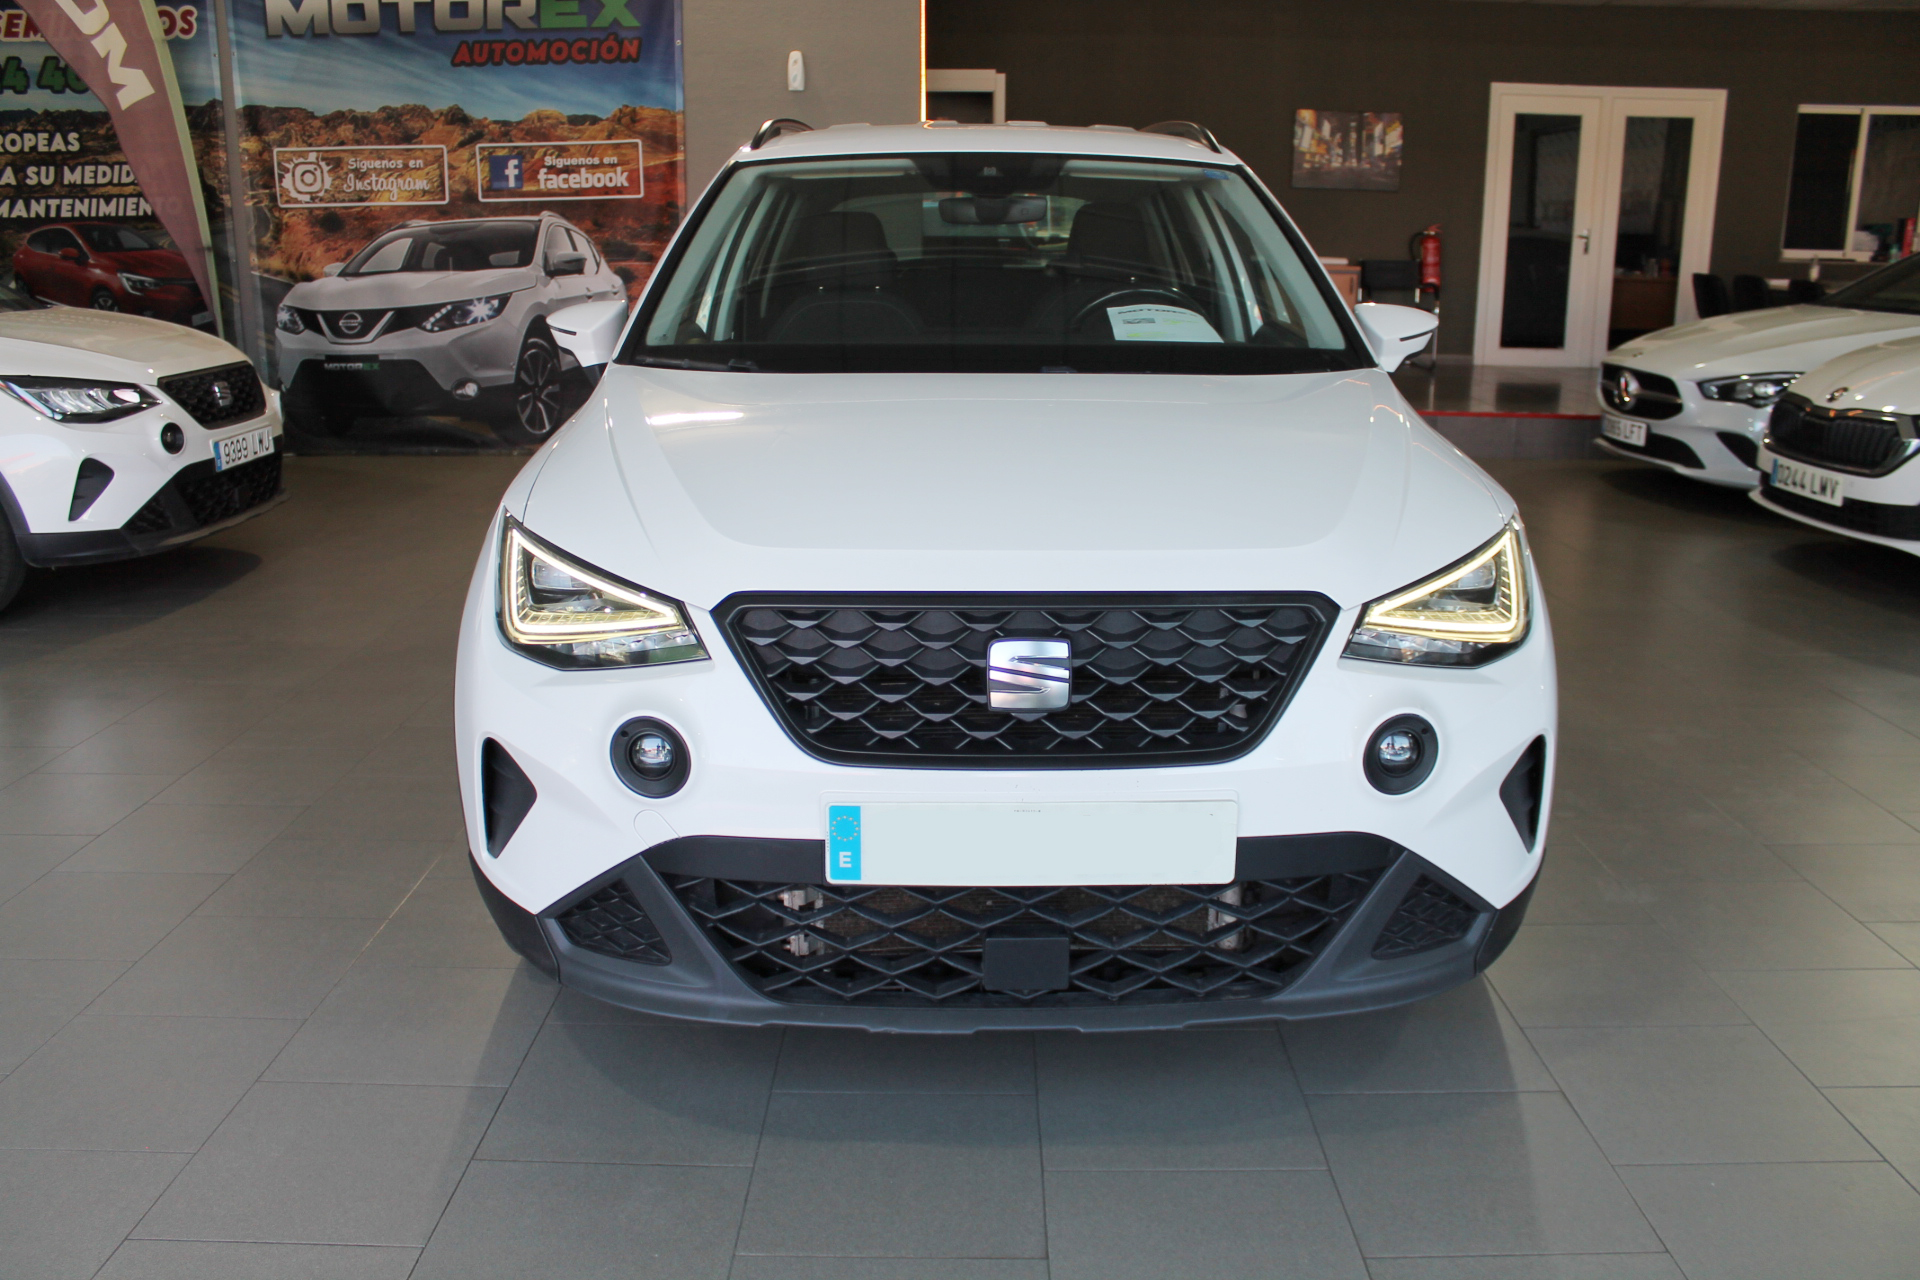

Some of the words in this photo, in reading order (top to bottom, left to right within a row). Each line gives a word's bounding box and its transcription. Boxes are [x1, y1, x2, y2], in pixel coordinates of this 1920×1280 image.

[265, 0, 642, 36] MOTOREX
[453, 34, 640, 66] AUTOMOCIÓN
[408, 159, 424, 168] en
[603, 156, 618, 164] en
[25, 165, 55, 185] SU
[63, 164, 137, 185] MEDID
[538, 167, 629, 189] facebook
[343, 173, 430, 201] Instagram
[839, 851, 852, 868] E
